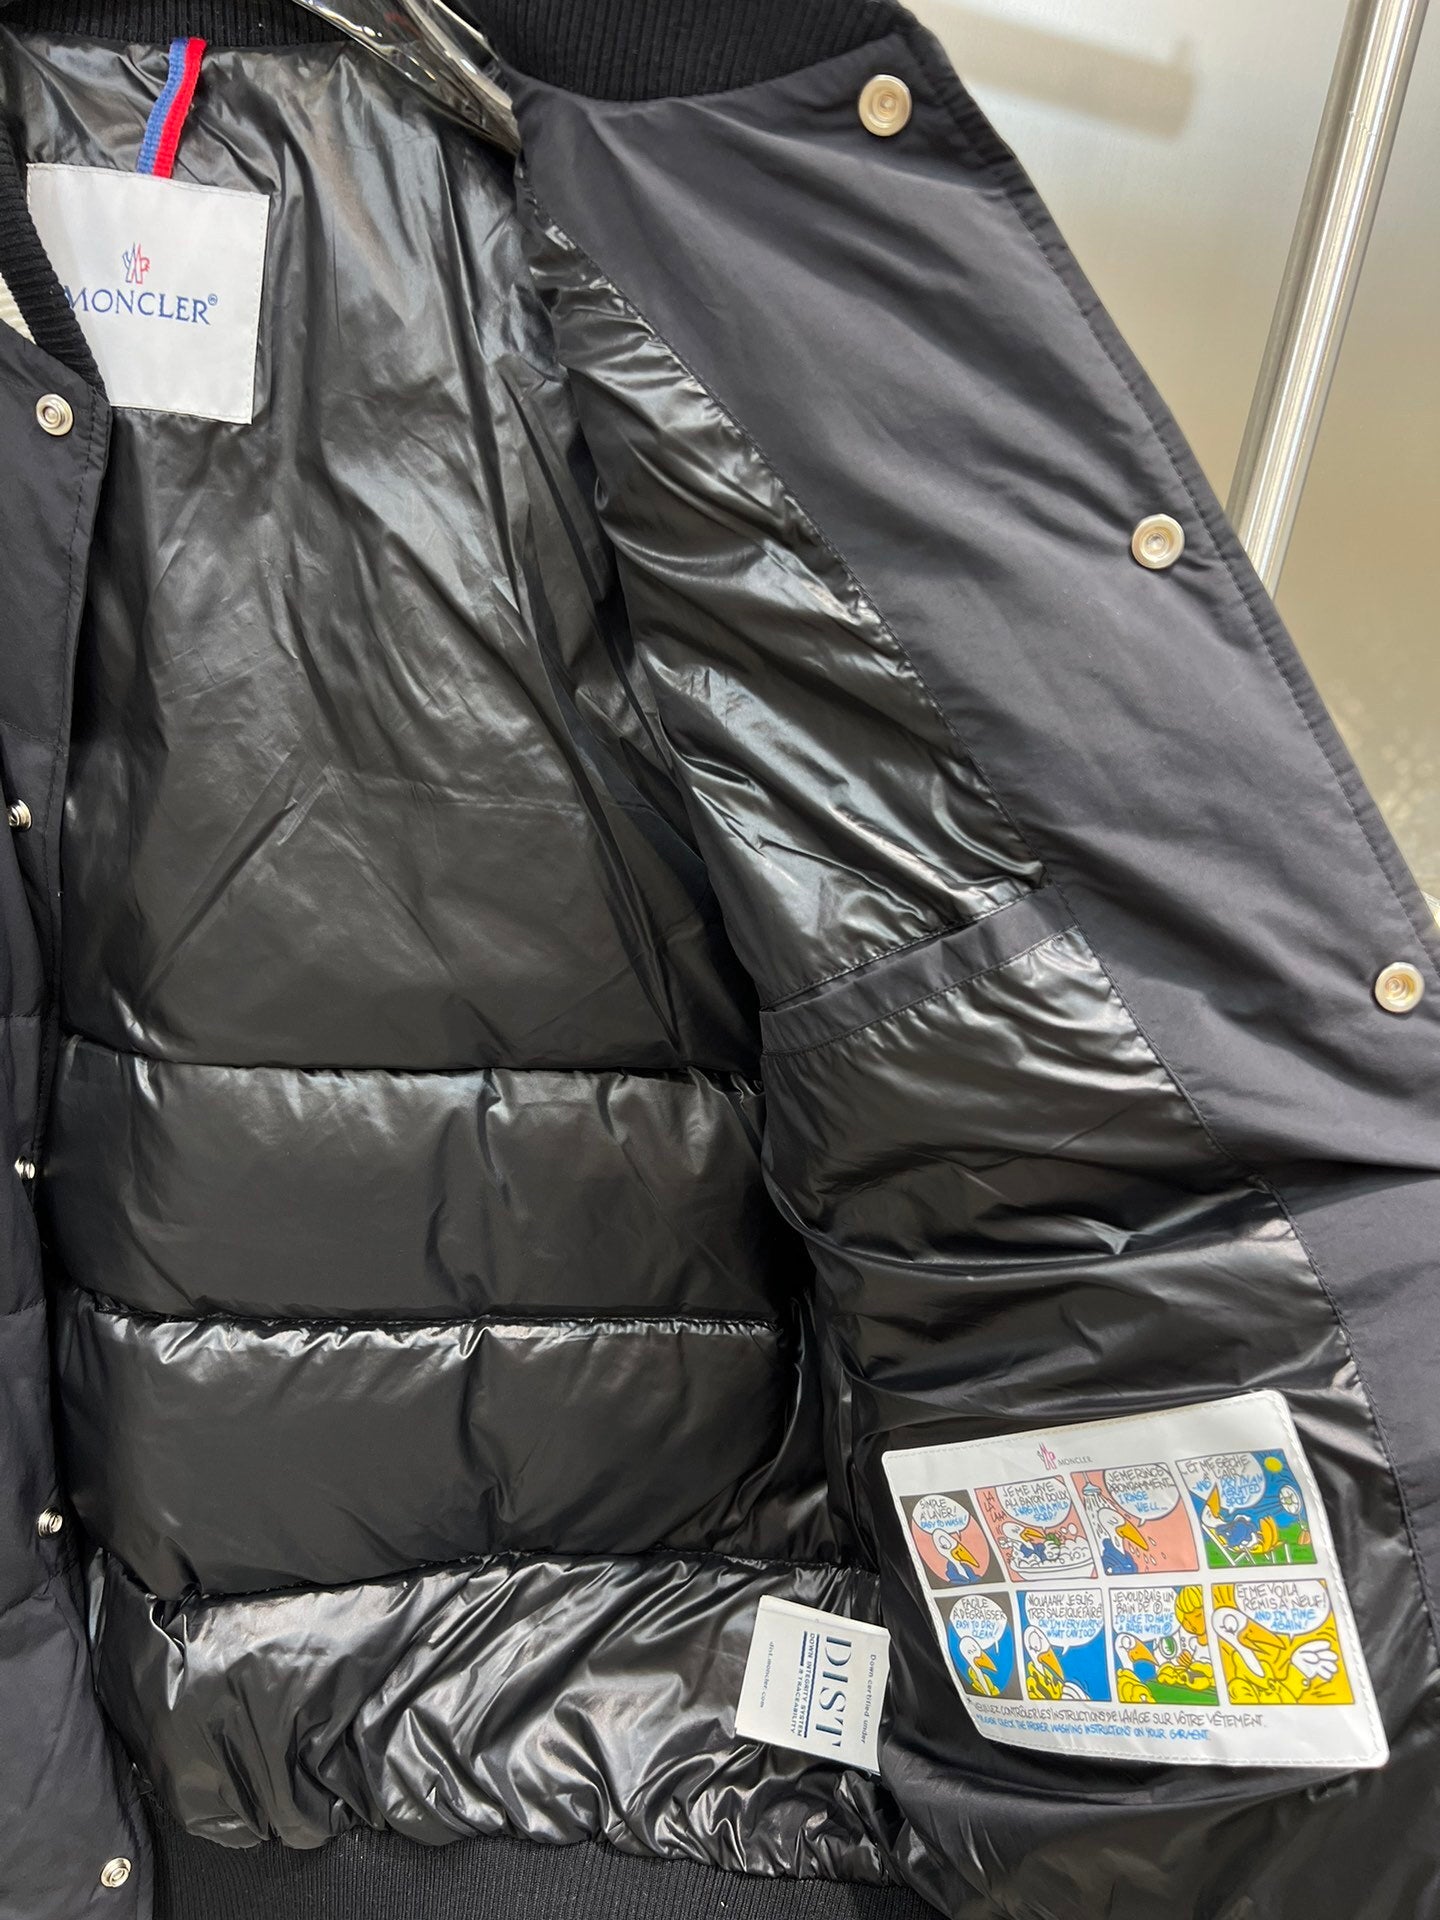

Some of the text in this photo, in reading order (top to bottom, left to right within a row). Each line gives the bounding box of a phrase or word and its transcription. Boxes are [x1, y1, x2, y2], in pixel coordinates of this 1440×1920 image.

[1058, 1456, 1093, 1466] MONCLER
[1015, 1484, 1030, 1496] ME
[1046, 1490, 1070, 1502] DOUX
[1163, 1592, 1174, 1602] UN
[1237, 1584, 1247, 1599] ET
[1249, 1584, 1266, 1597] ME
[962, 1597, 988, 1610] FACILE
[1243, 1598, 1278, 1611] REMIS
[1145, 1614, 1154, 1623] TO
[1254, 1610, 1271, 1620] AND
[1291, 1608, 1316, 1620] FINE
[972, 1620, 980, 1629] TO
[981, 1620, 996, 1630] DRY
[868, 1654, 876, 1678] Down
[802, 1661, 812, 1702] INTEGRITY
[816, 1636, 852, 1747] DIST
[862, 1679, 873, 1717] certified
[791, 1675, 804, 1734] TRACEABILITY
[798, 1704, 806, 1736] SYSTEM
[1153, 1712, 1173, 1726] SUR
[1134, 1728, 1144, 1737] ON
[1145, 1727, 1166, 1739] YOUR
